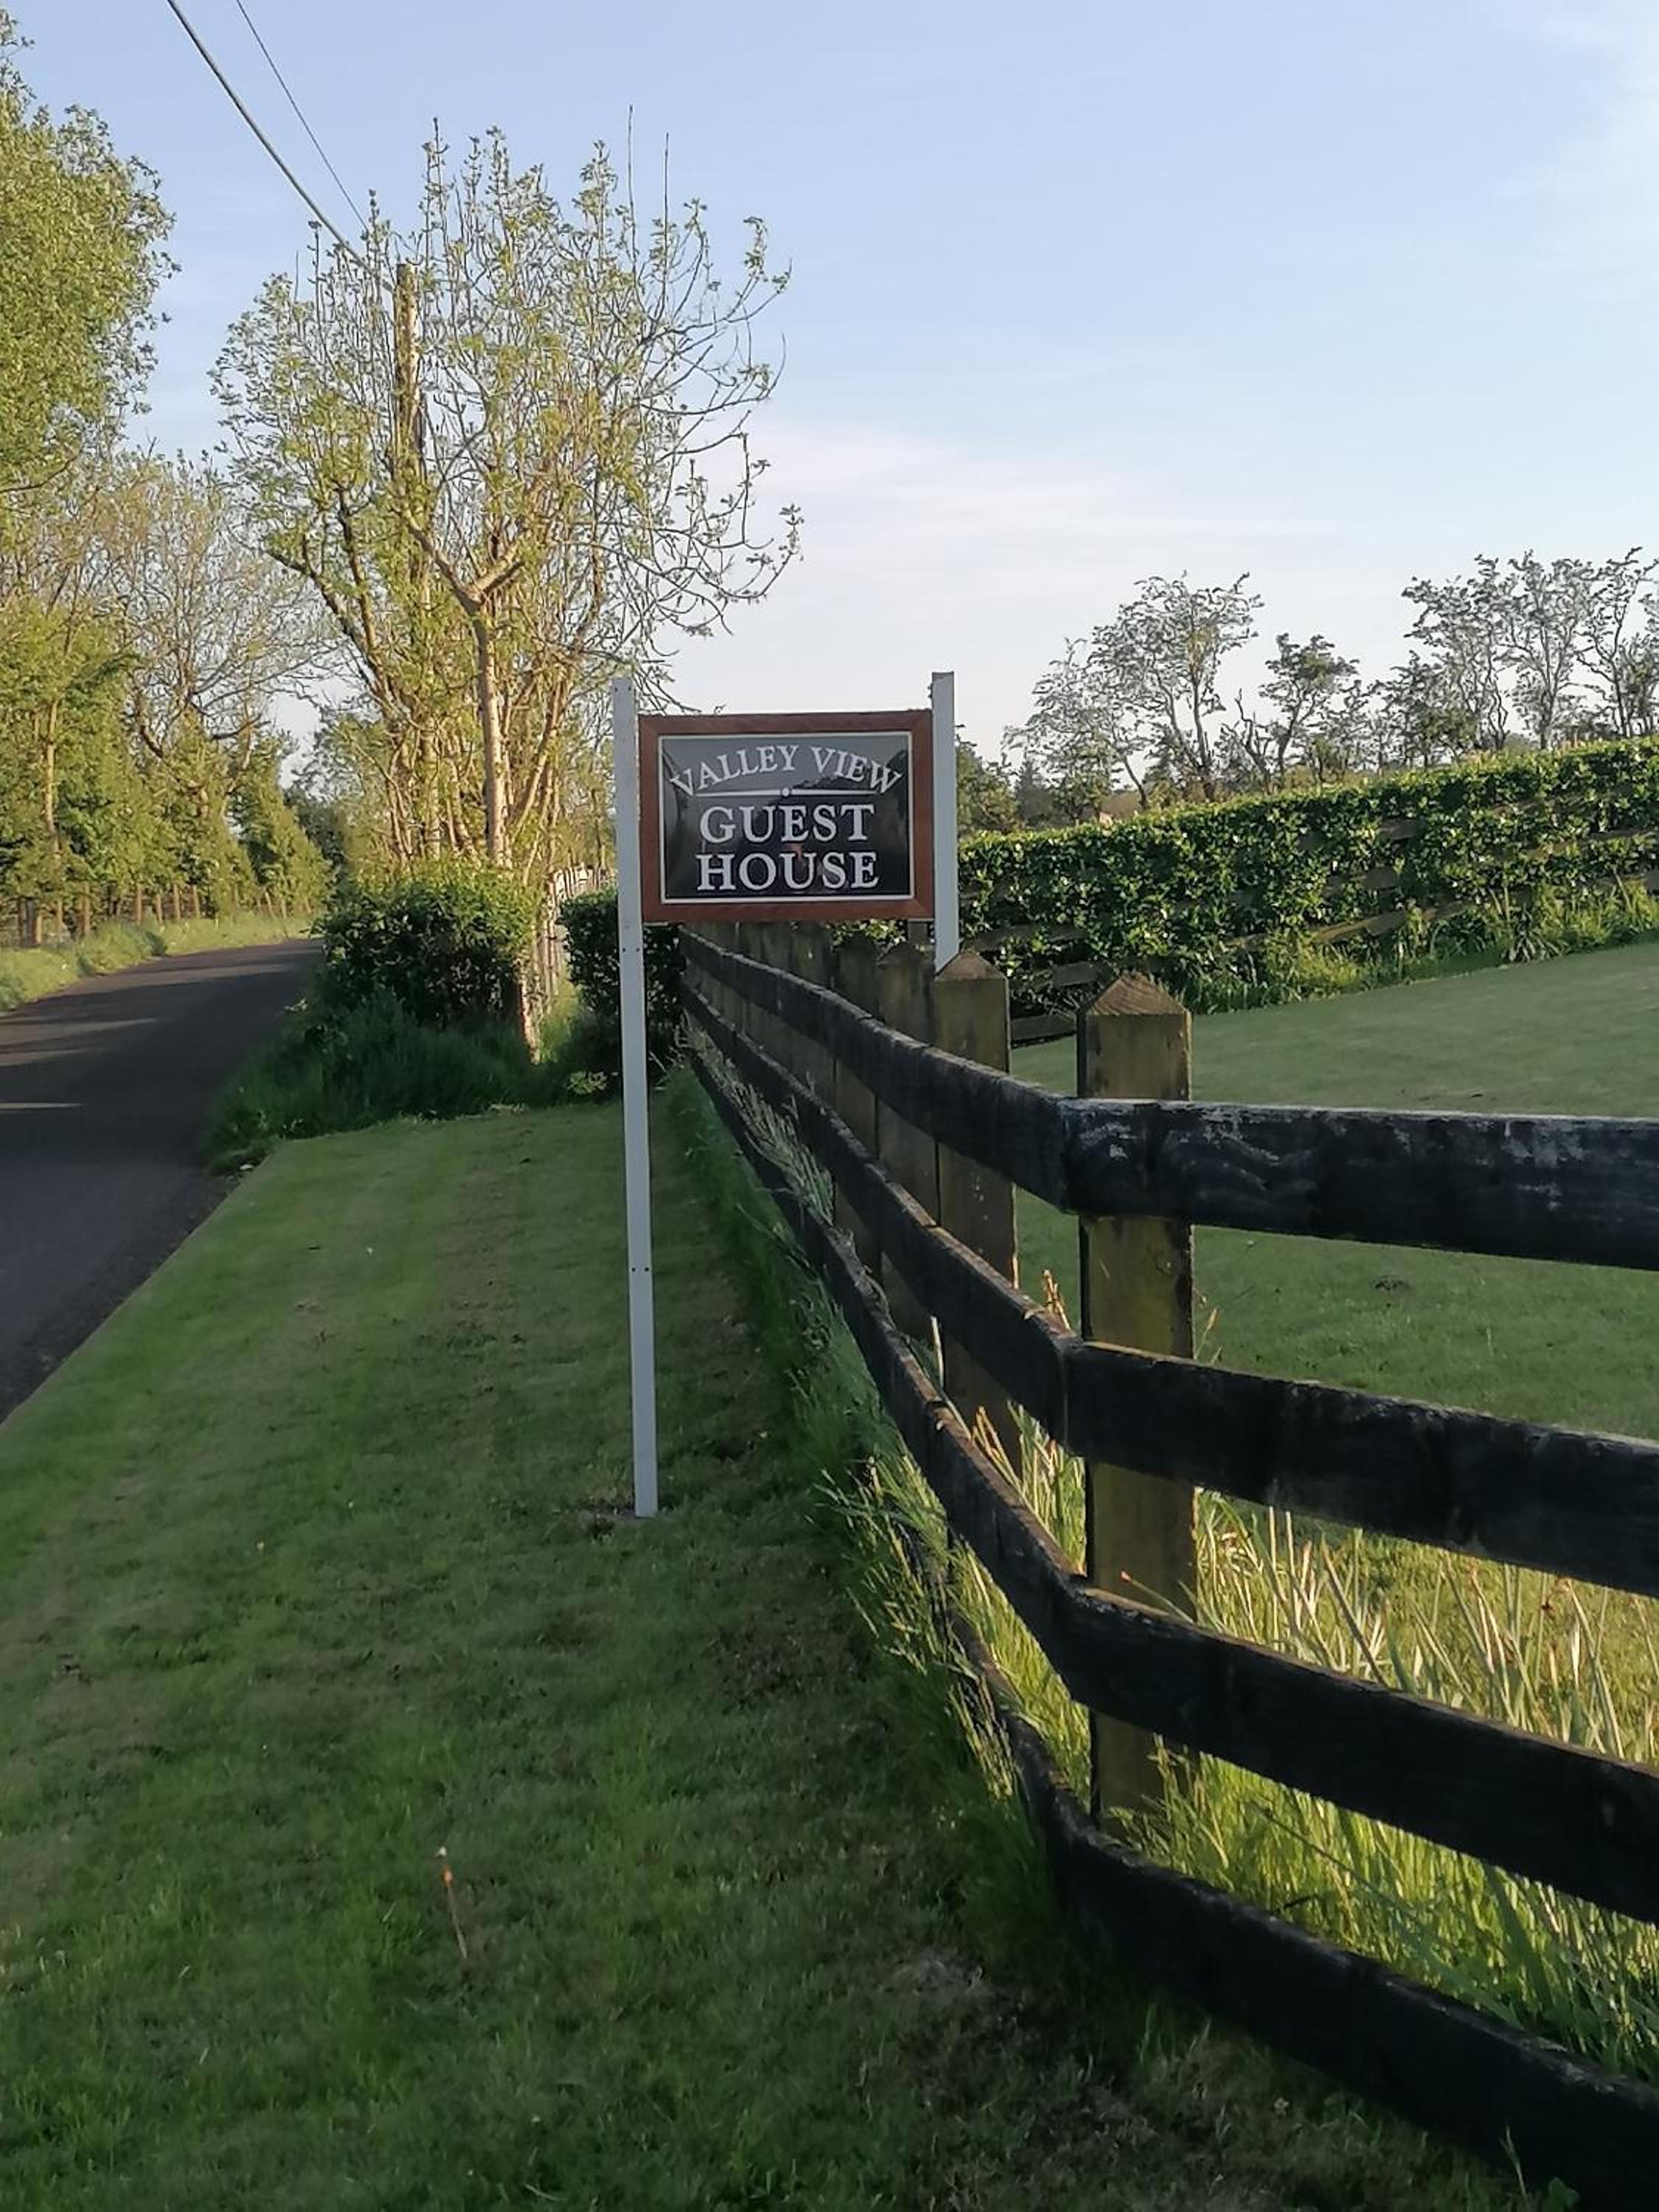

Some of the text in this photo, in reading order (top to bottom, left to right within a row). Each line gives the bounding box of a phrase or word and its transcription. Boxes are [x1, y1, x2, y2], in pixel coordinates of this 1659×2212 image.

[669, 745, 903, 796] VALLEY VIEW
[699, 804, 874, 844] GUEST
[695, 851, 880, 891] HOUSE
